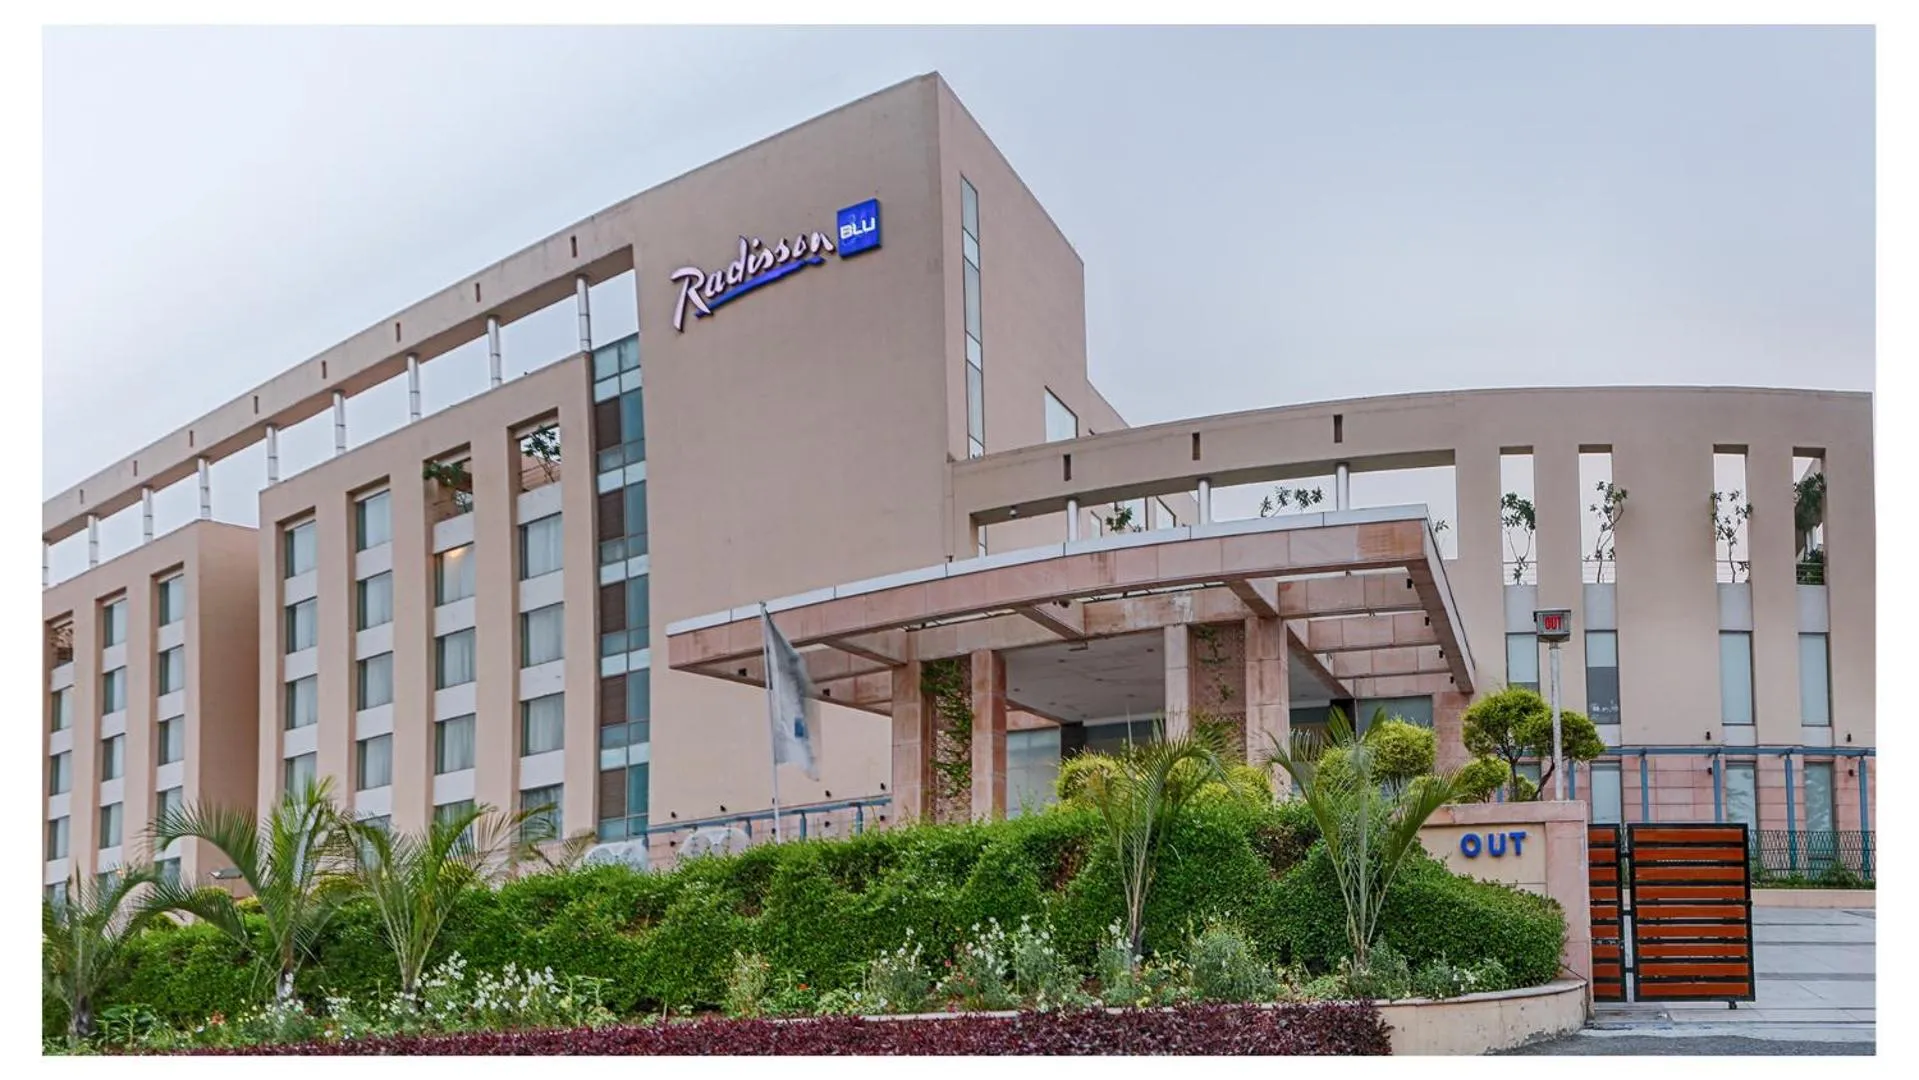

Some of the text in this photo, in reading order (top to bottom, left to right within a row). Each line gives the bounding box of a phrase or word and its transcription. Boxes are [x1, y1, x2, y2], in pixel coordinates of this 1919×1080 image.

[670, 217, 876, 332] Radisson BLU
[1544, 615, 1562, 630] OUT
[1460, 831, 1527, 858] OUT
